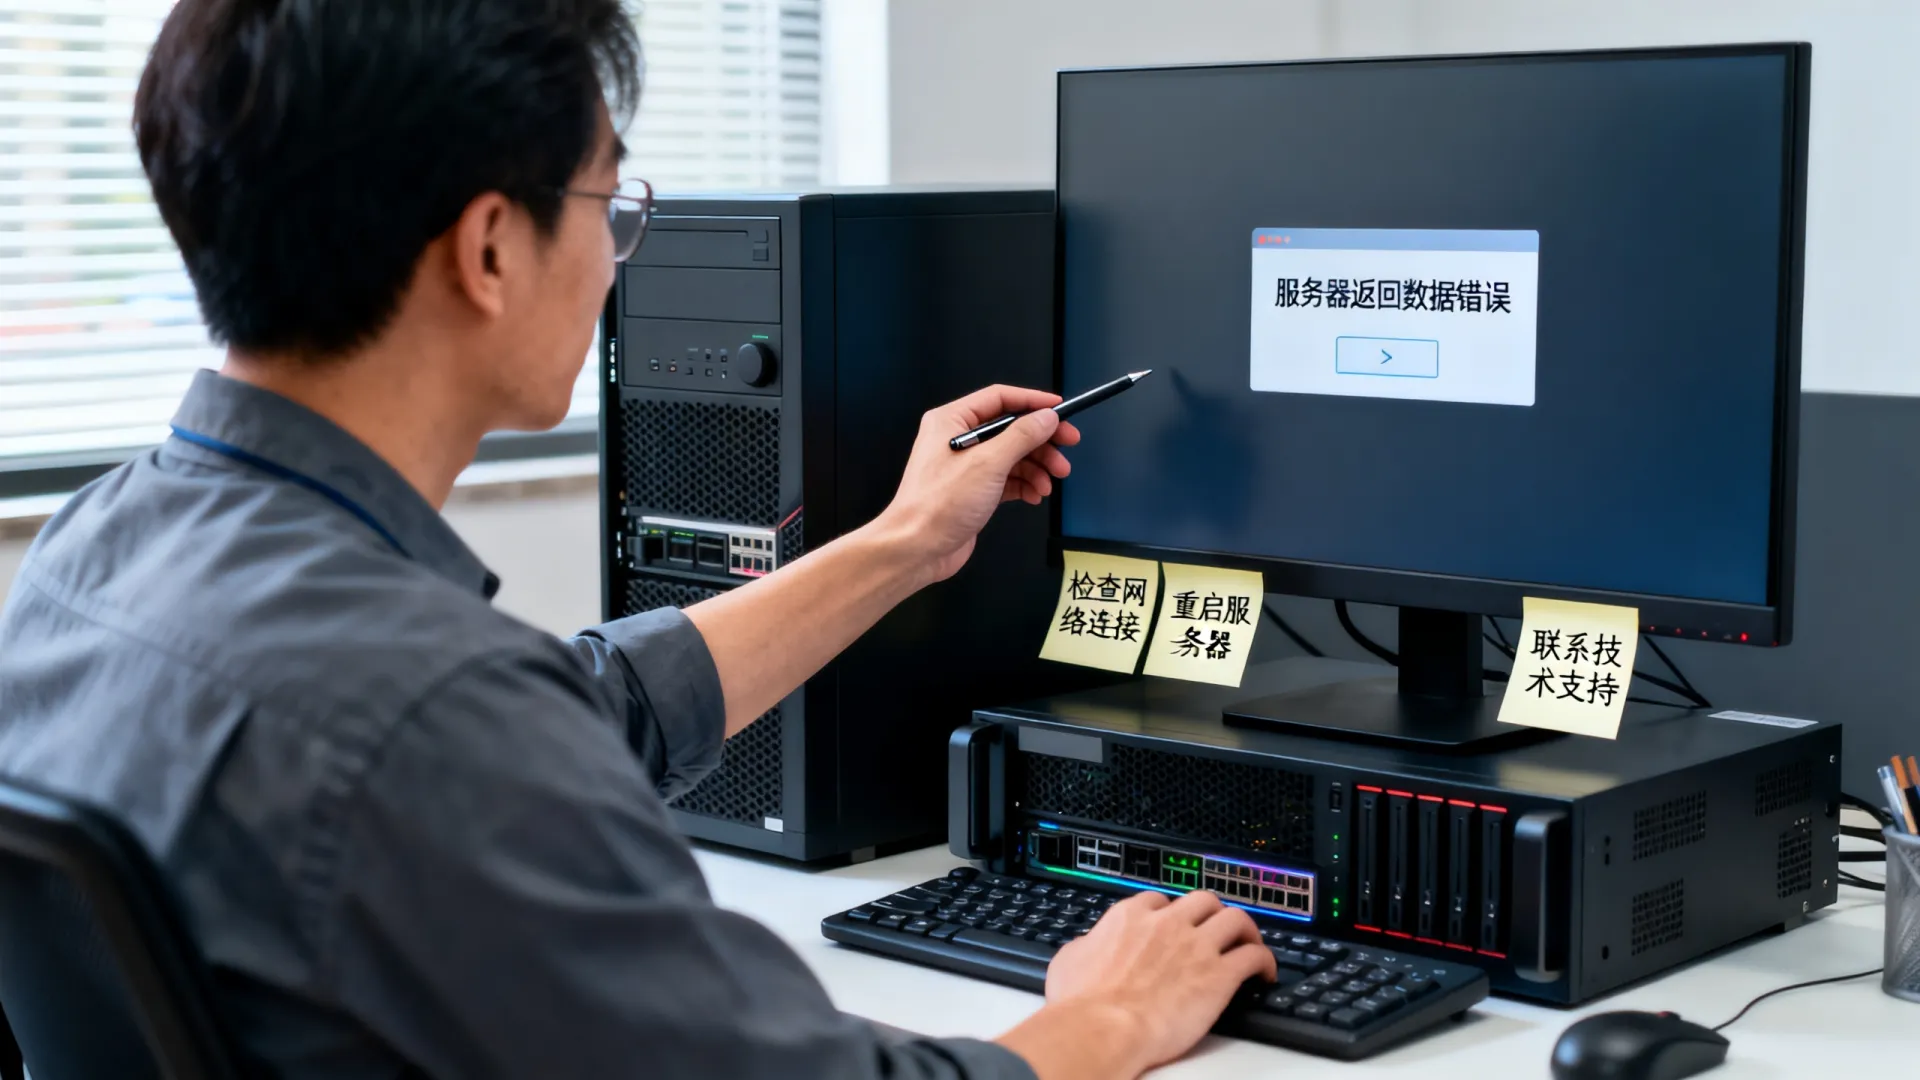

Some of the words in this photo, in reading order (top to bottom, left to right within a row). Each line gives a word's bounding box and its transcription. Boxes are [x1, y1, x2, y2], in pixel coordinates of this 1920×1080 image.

[1275, 277, 1511, 313] 服务器返回数据错误
[1067, 570, 1147, 606] 检查网
[1059, 605, 1141, 642] 络连接
[1170, 591, 1251, 625] 重启服
[1530, 629, 1622, 668] 联系技
[1525, 667, 1620, 706] 术支持
